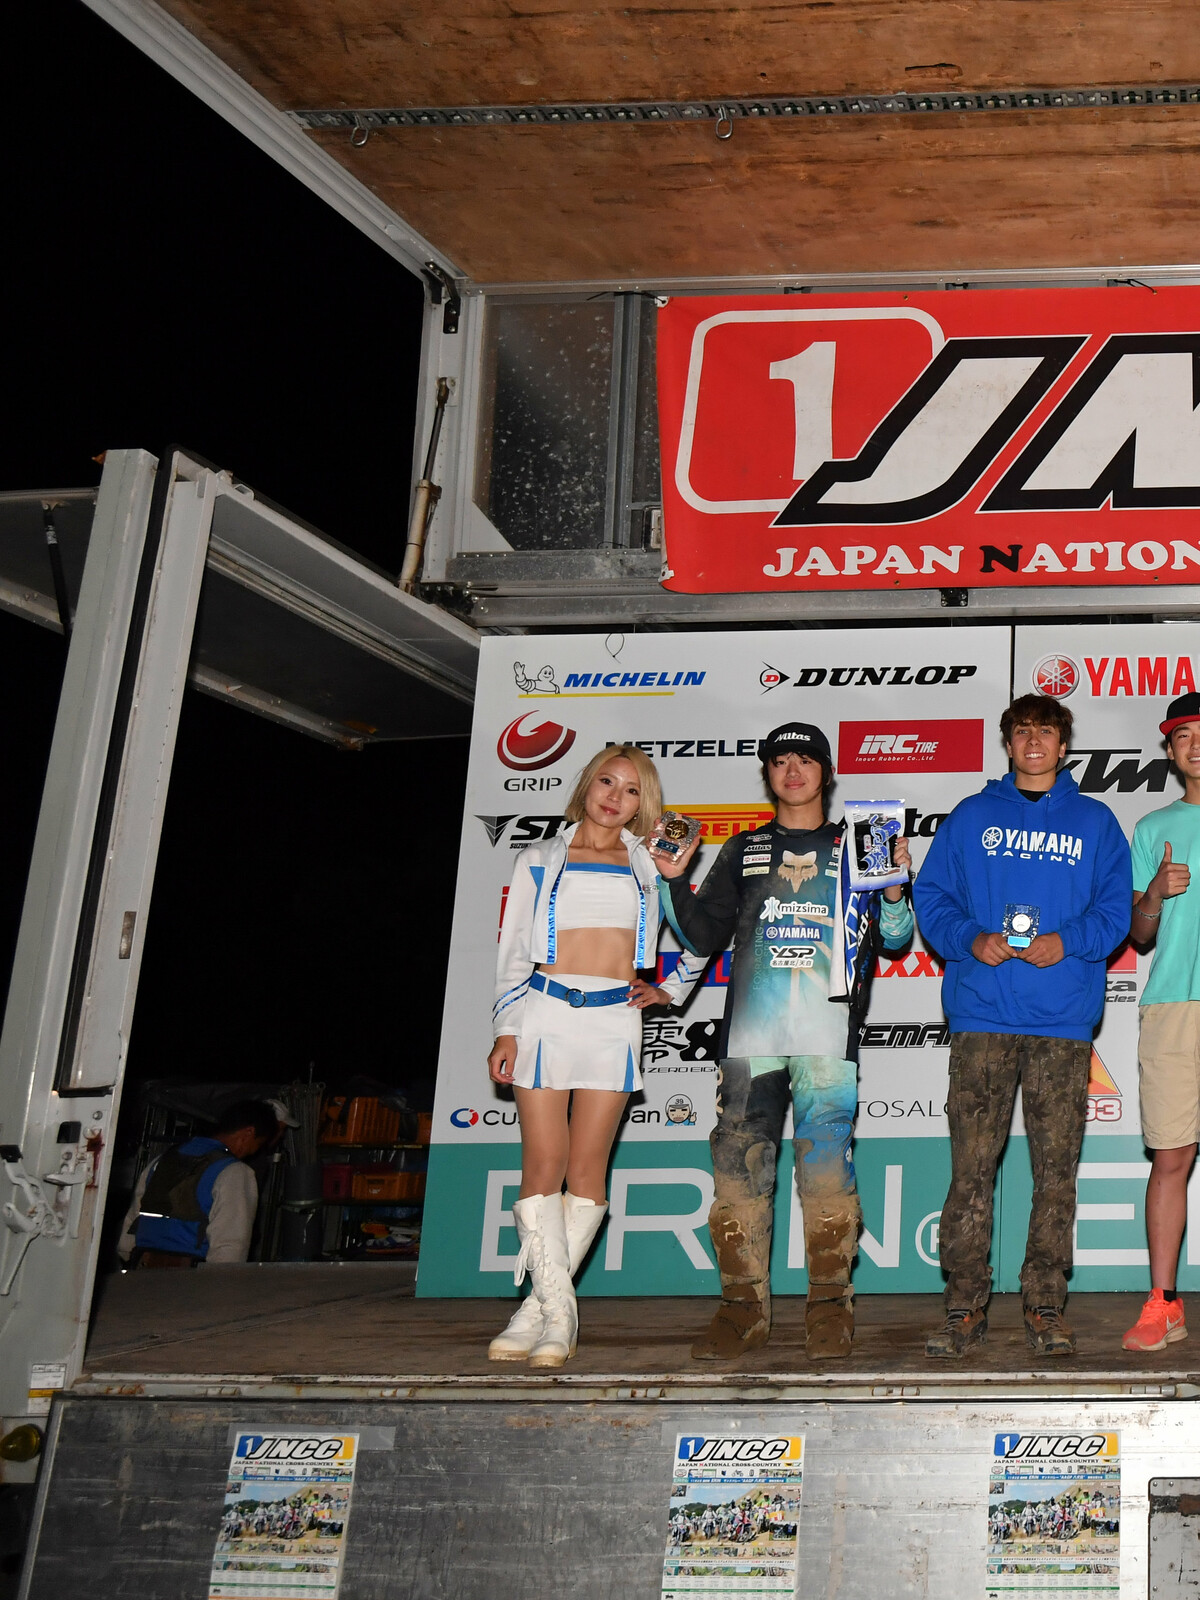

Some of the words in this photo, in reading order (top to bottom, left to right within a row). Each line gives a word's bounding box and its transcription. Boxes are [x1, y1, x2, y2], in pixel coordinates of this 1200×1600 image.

[769, 341, 837, 481] 1
[762, 545, 965, 577] JAPAN
[564, 671, 706, 688] MICHELIN
[793, 665, 978, 687] DUNLOP
[914, 741, 939, 753] TIRE
[503, 777, 562, 791] GRIP
[1005, 829, 1083, 860] YAMAHA
[987, 850, 1076, 866] RACING
[781, 903, 827, 914] mizsima
[778, 927, 820, 939] YAMAHA
[771, 947, 815, 958] YSP
[246, 1438, 344, 1460] JNCC
[688, 1439, 789, 1462] JNCC
[1005, 1435, 1106, 1458] JNCC
